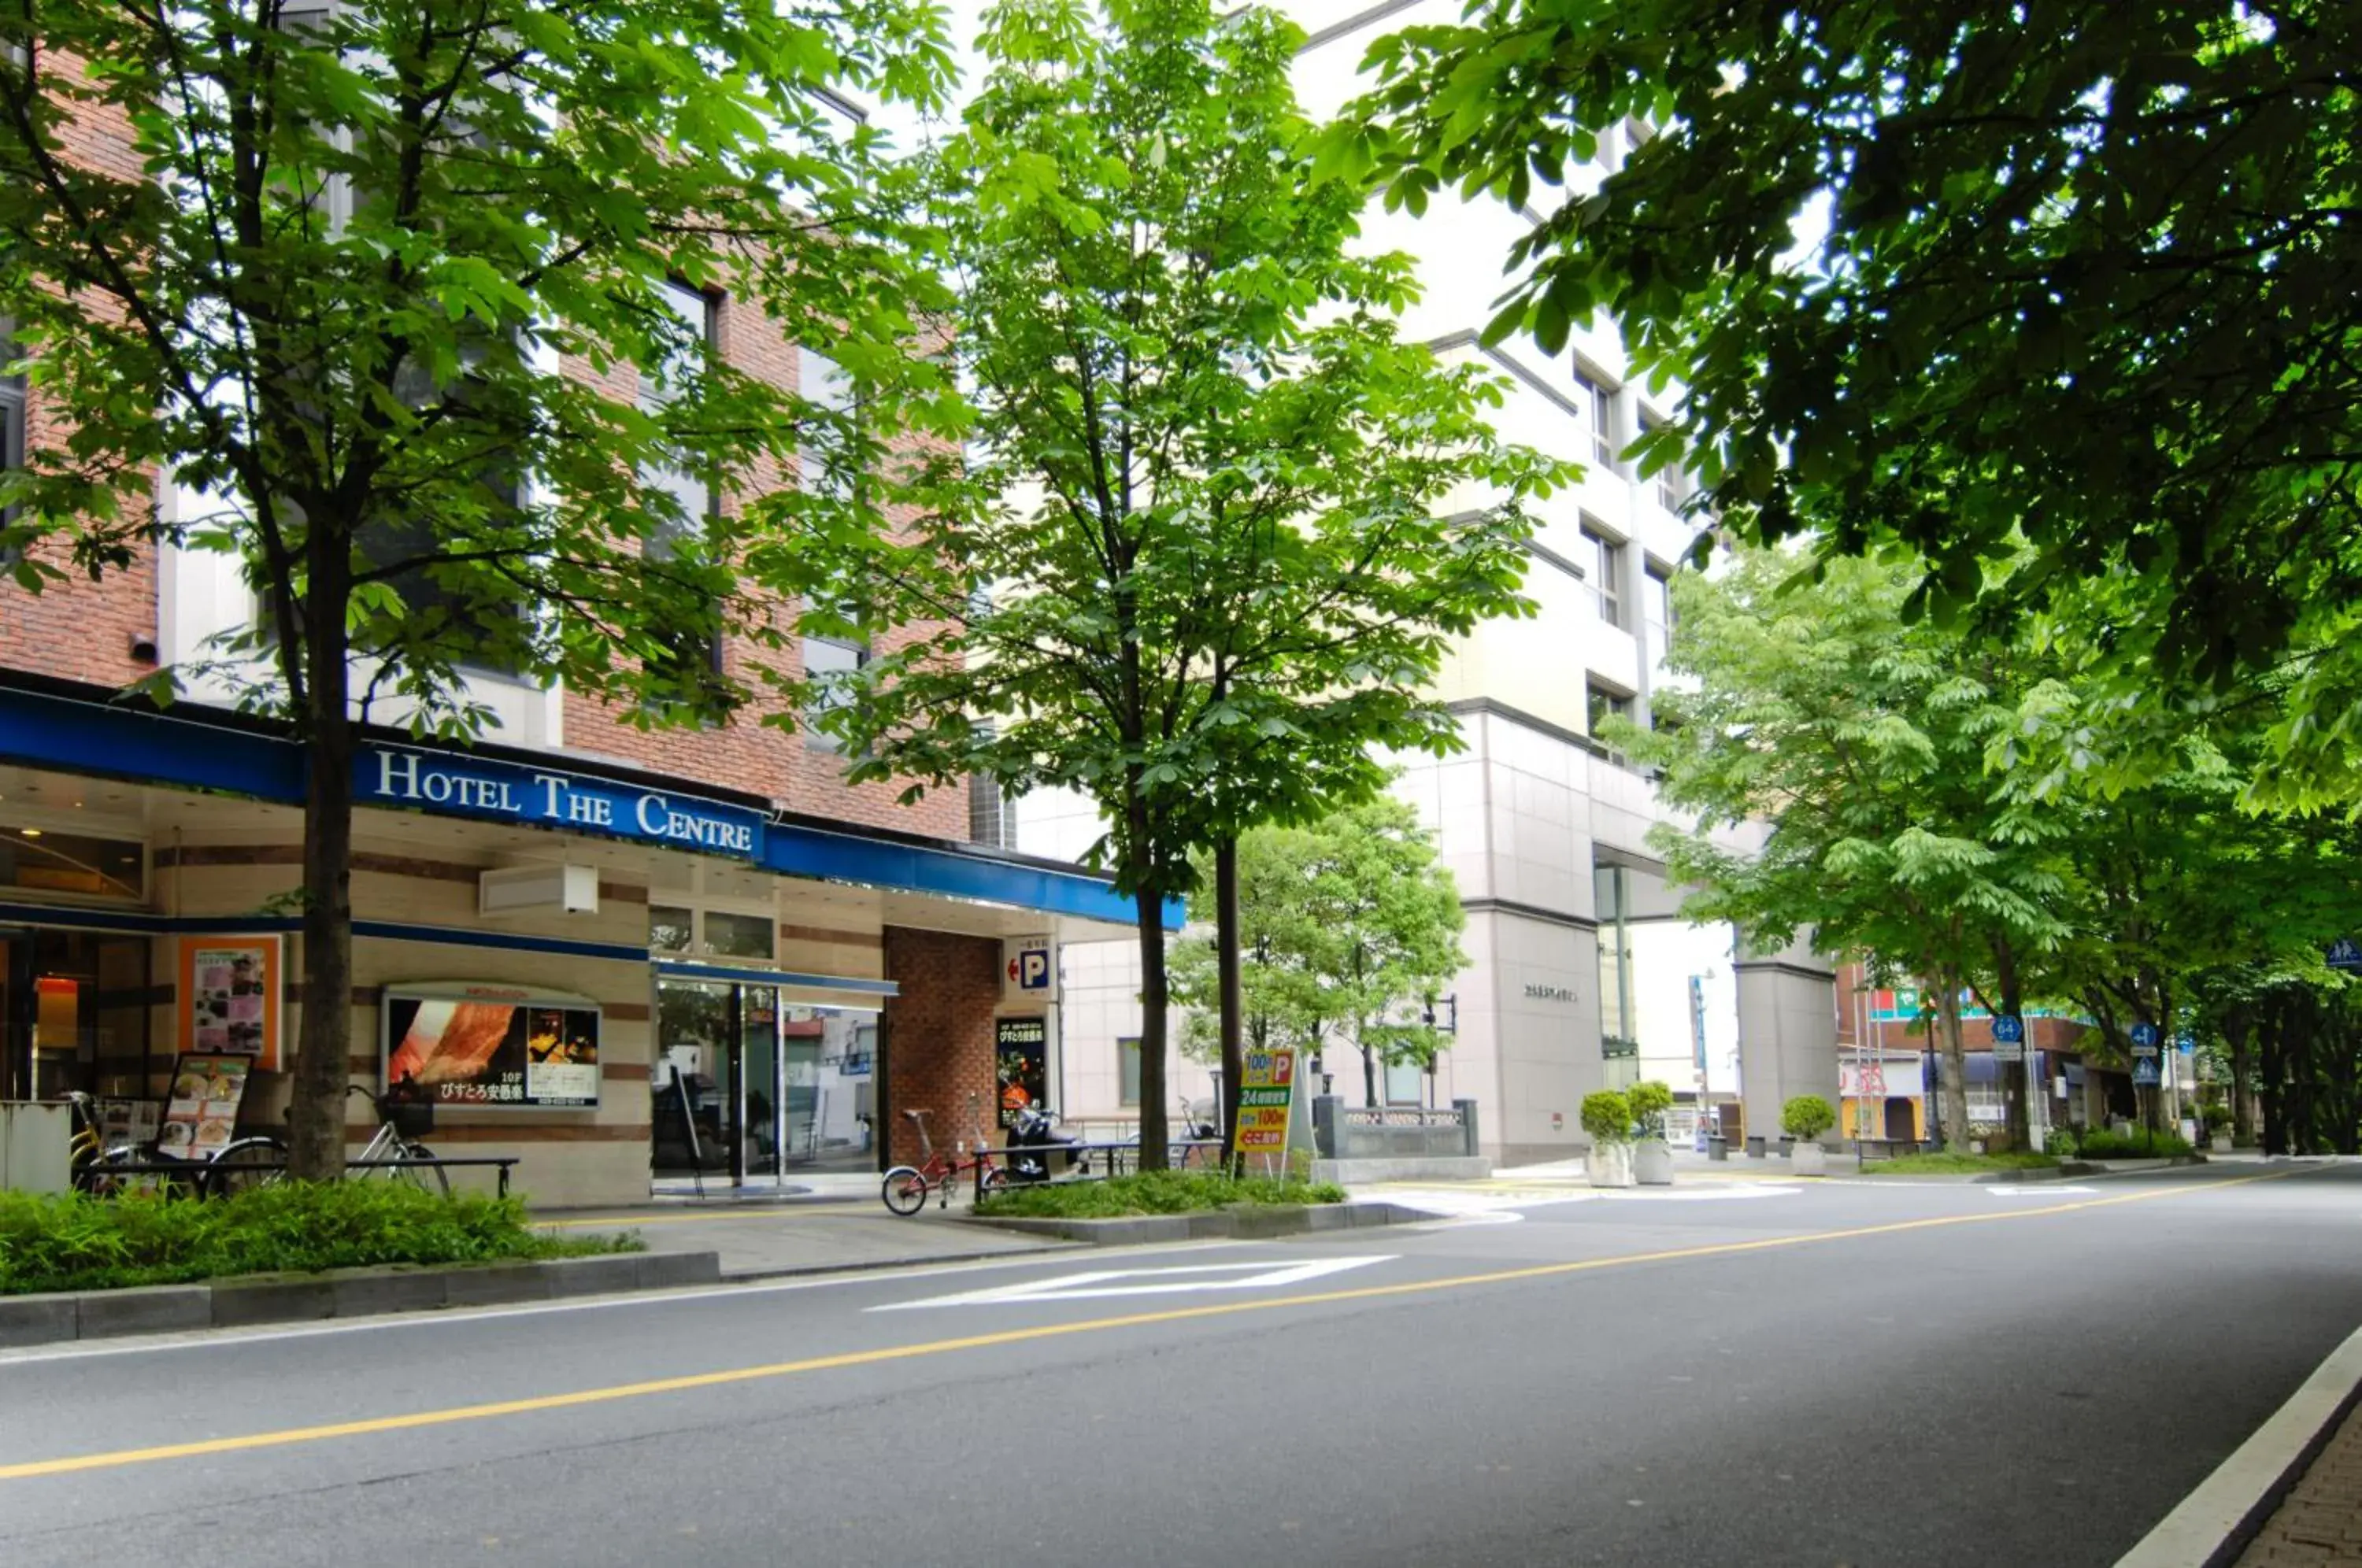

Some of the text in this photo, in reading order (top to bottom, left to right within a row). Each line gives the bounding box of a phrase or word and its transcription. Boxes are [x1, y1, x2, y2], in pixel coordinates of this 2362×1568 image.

[374, 749, 753, 852] HOTEL THE CENTRE
